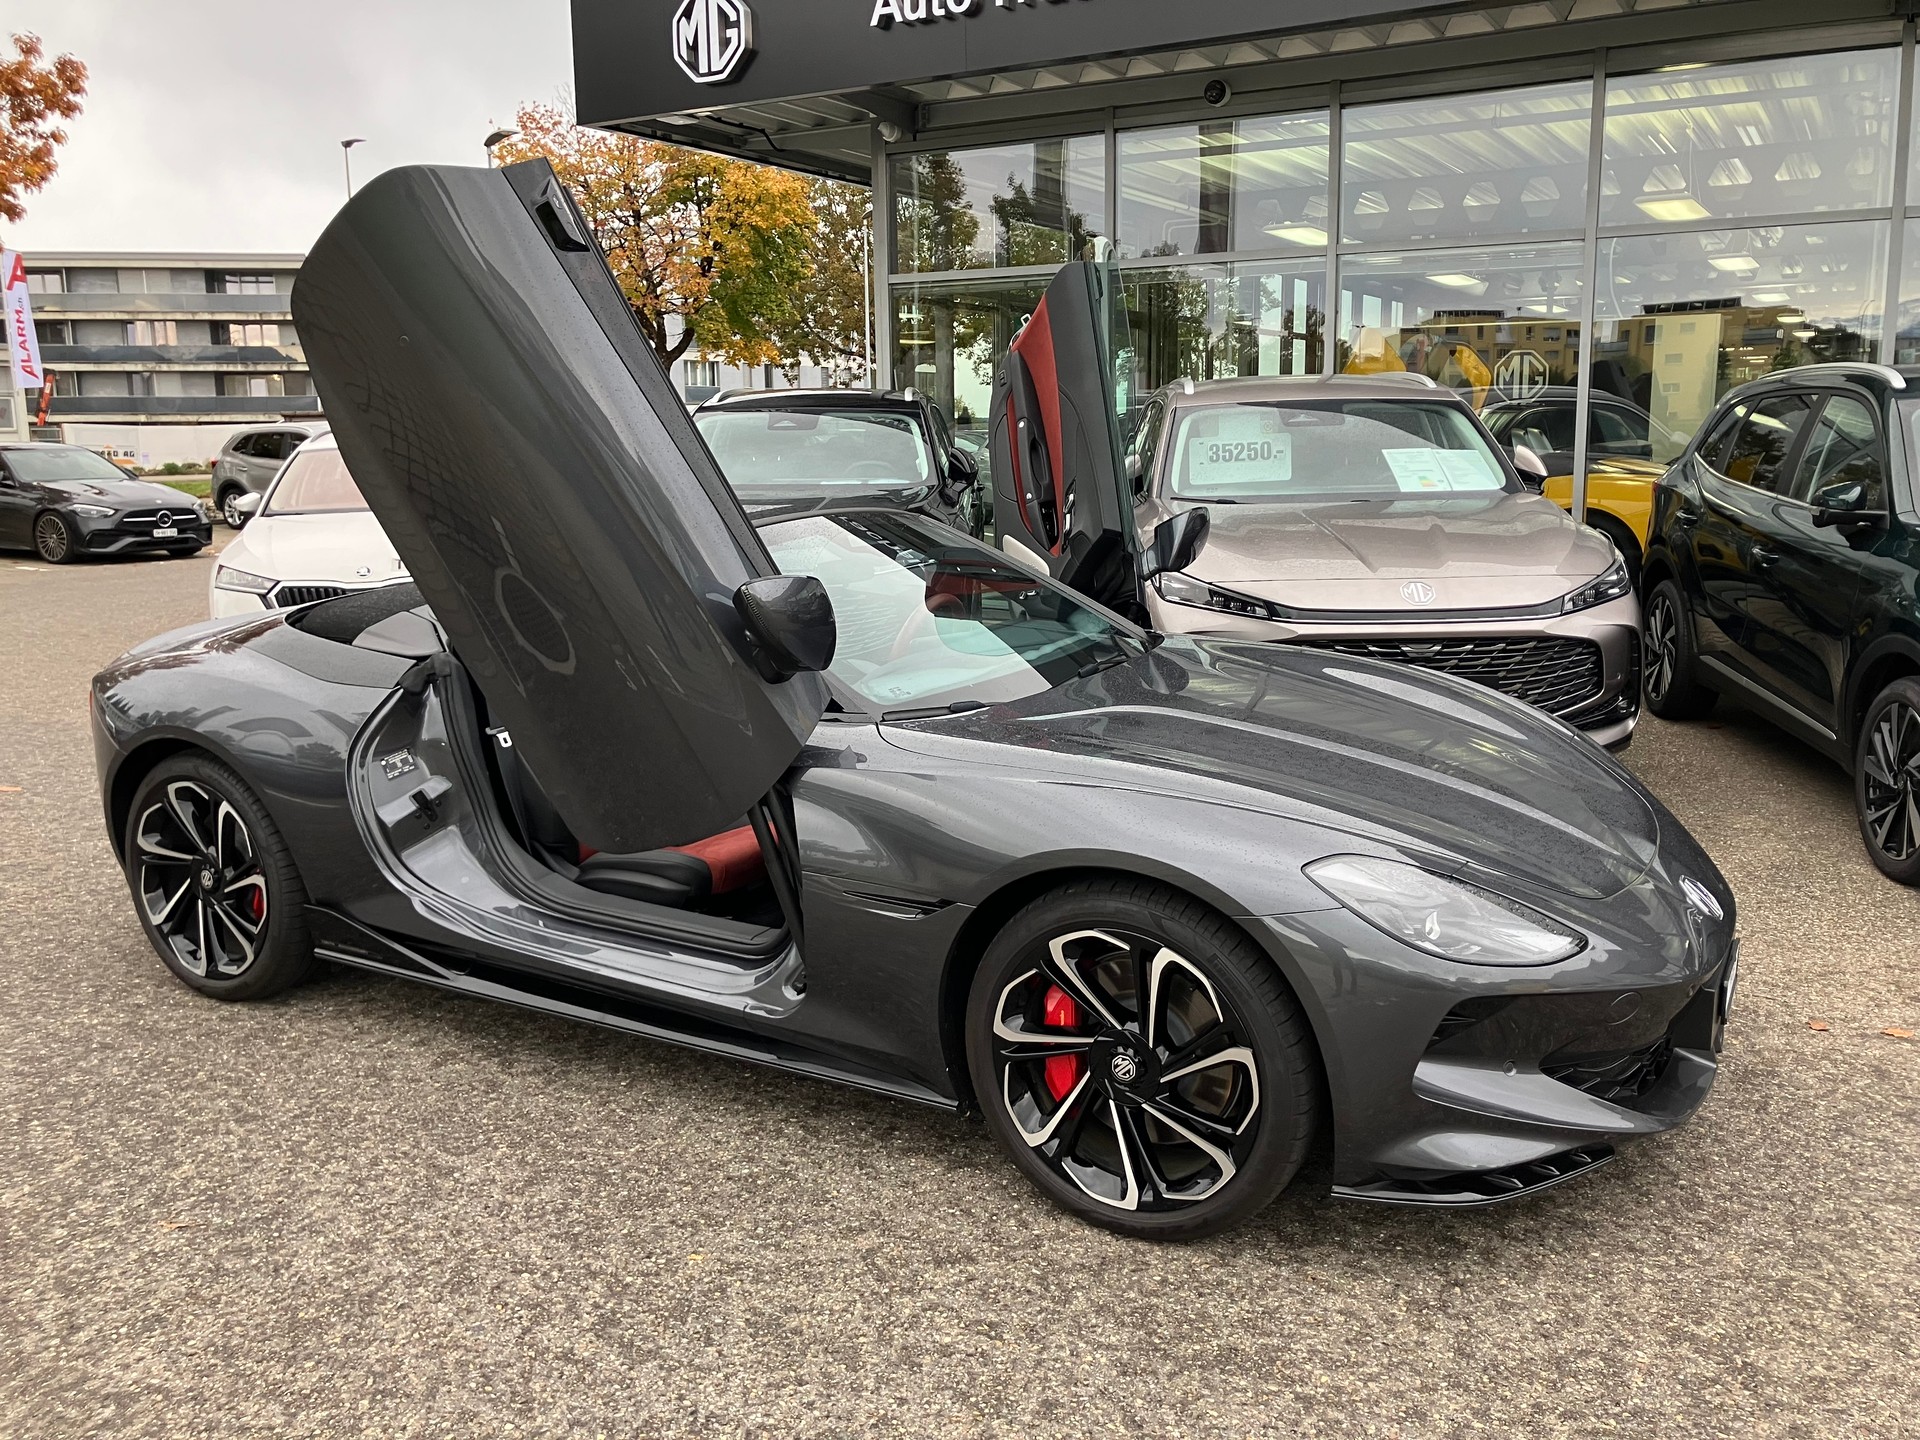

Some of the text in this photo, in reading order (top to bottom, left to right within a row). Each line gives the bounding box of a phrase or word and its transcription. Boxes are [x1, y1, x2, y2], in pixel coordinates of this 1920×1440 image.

[679, 0, 739, 73] MG
[1499, 355, 1543, 399] MG
[1208, 441, 1284, 463] 35250.-
[1403, 583, 1433, 602] MG
[1114, 1057, 1133, 1078] MG
